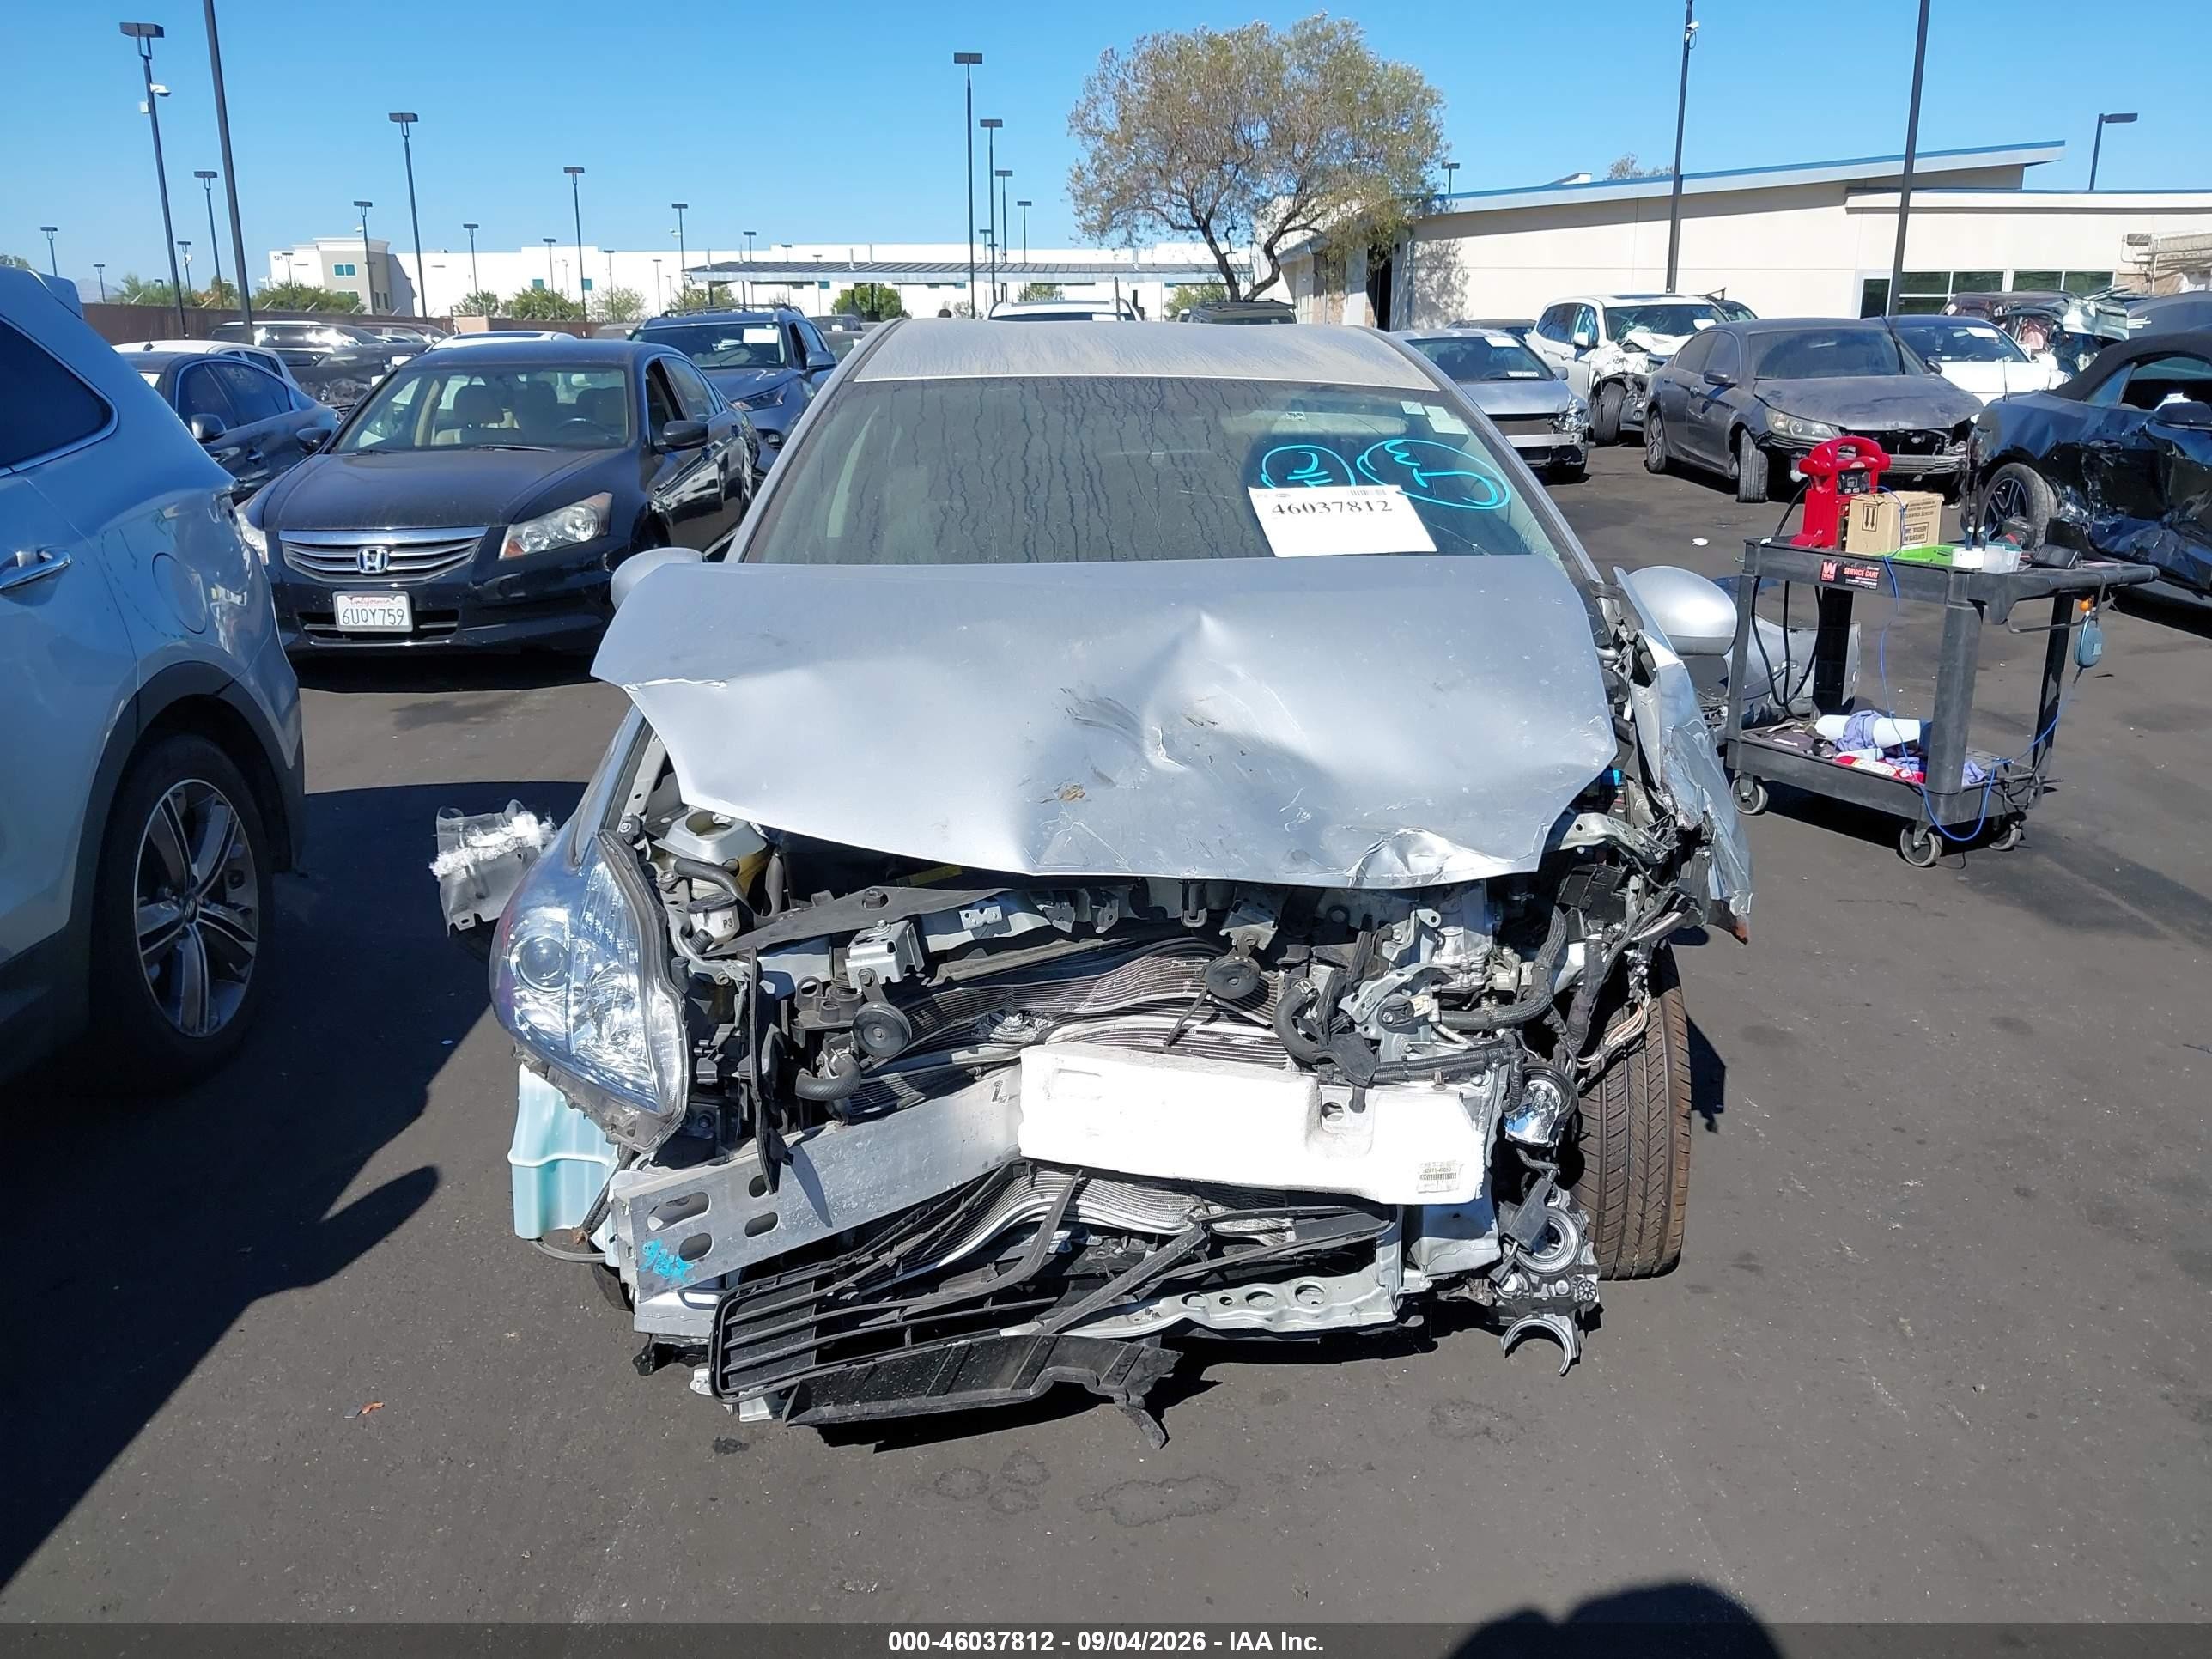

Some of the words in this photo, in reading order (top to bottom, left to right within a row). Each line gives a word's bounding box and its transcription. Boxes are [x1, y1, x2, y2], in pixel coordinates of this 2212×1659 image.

[1272, 501, 1393, 515] 46037812
[1844, 568, 1865, 577] SERVICE
[1865, 570, 1879, 579] CART
